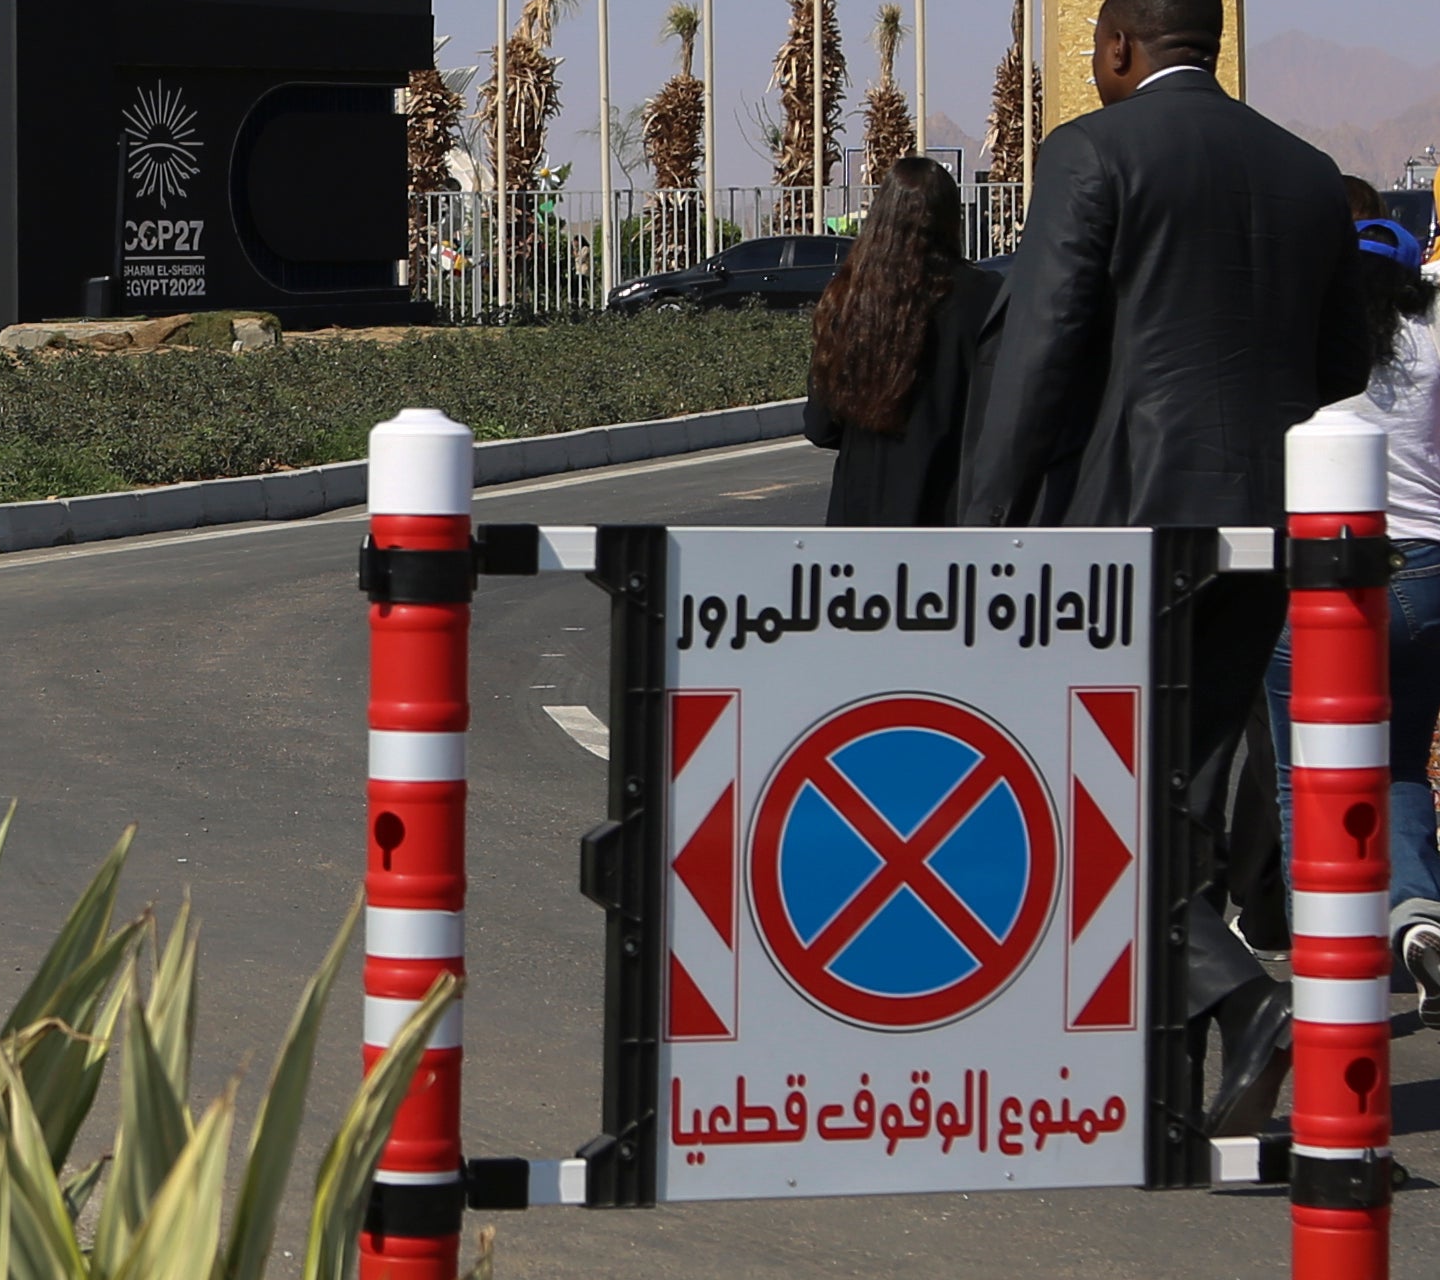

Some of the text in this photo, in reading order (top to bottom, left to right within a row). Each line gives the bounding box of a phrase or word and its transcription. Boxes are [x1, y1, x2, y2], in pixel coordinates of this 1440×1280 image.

[676, 563, 1134, 650] الادارة العامة للمرور
[671, 1066, 1126, 1165] ممنوع الوقوف قطعيا
